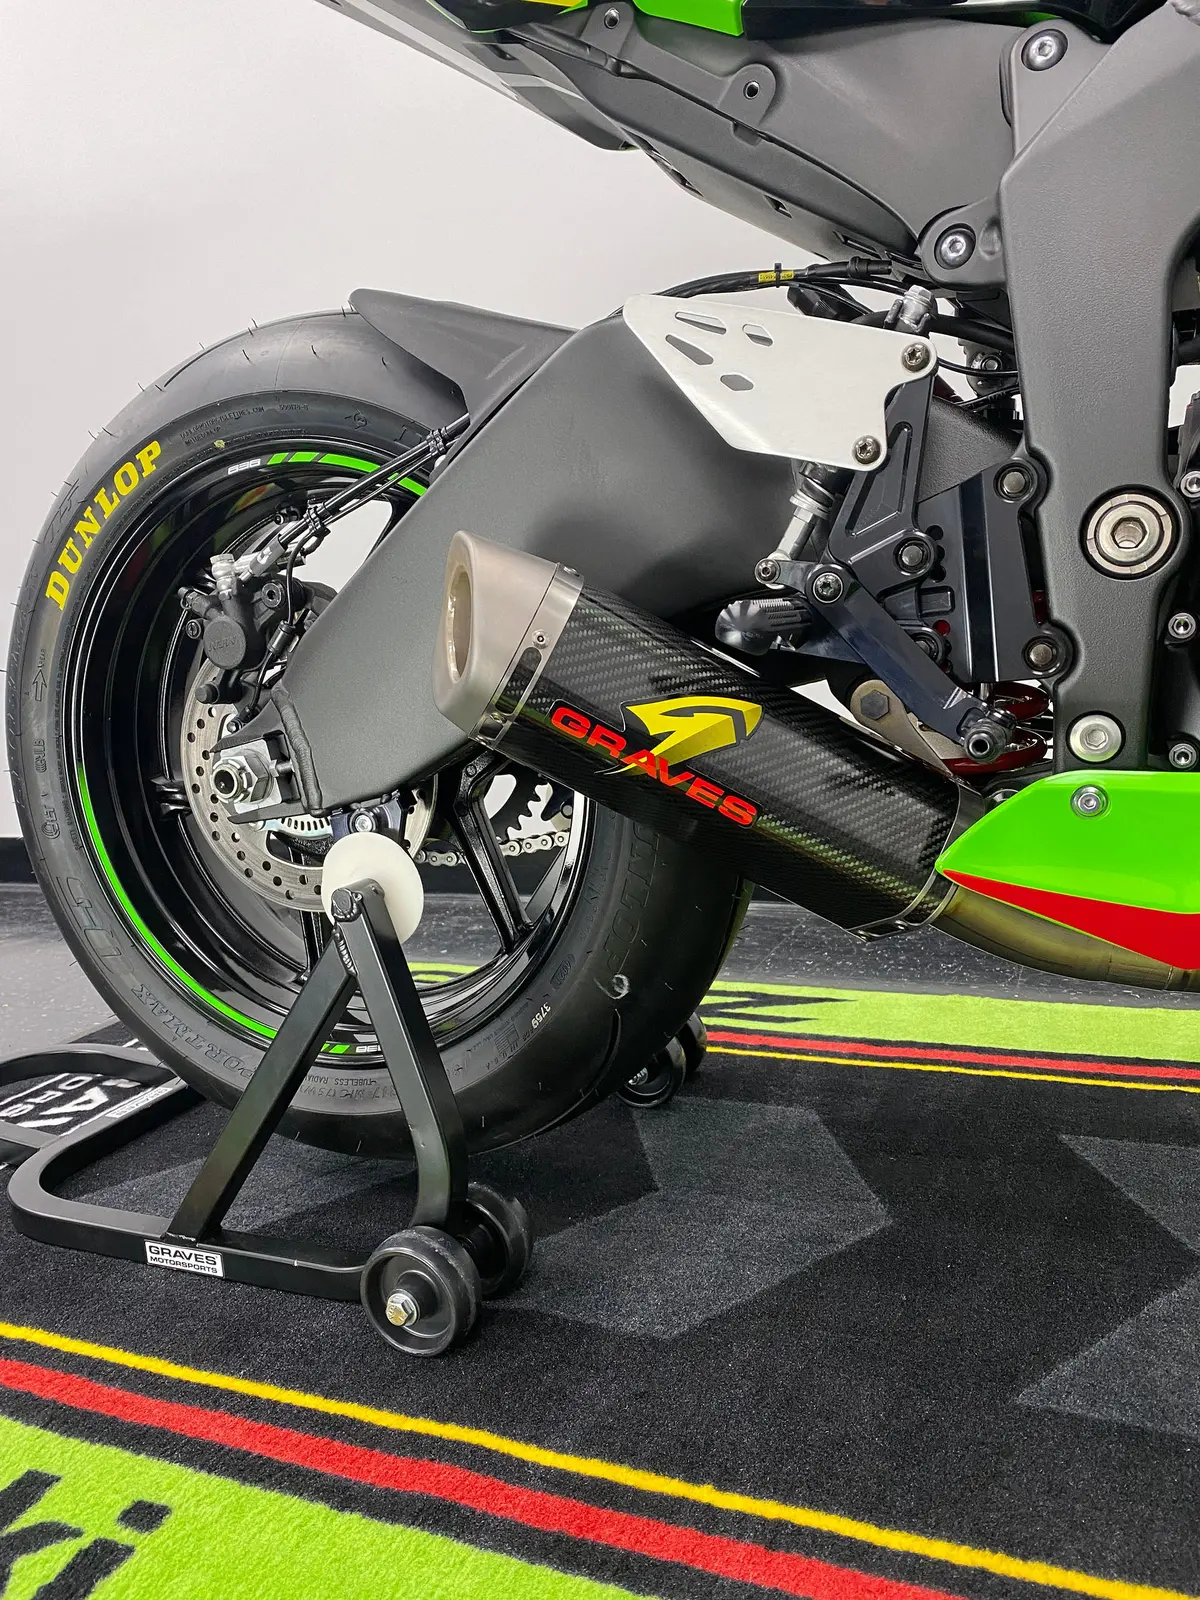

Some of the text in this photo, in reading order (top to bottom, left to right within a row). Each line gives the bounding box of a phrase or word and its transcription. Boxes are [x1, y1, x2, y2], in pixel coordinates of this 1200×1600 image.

[45, 440, 162, 611] DUNLOP
[551, 706, 757, 825] GRAVES
[131, 983, 257, 1080] PORTMAX
[531, 1002, 551, 1029] 3759
[148, 1245, 217, 1266] GRAVES
[150, 1256, 218, 1274] MOTORSPORTS
